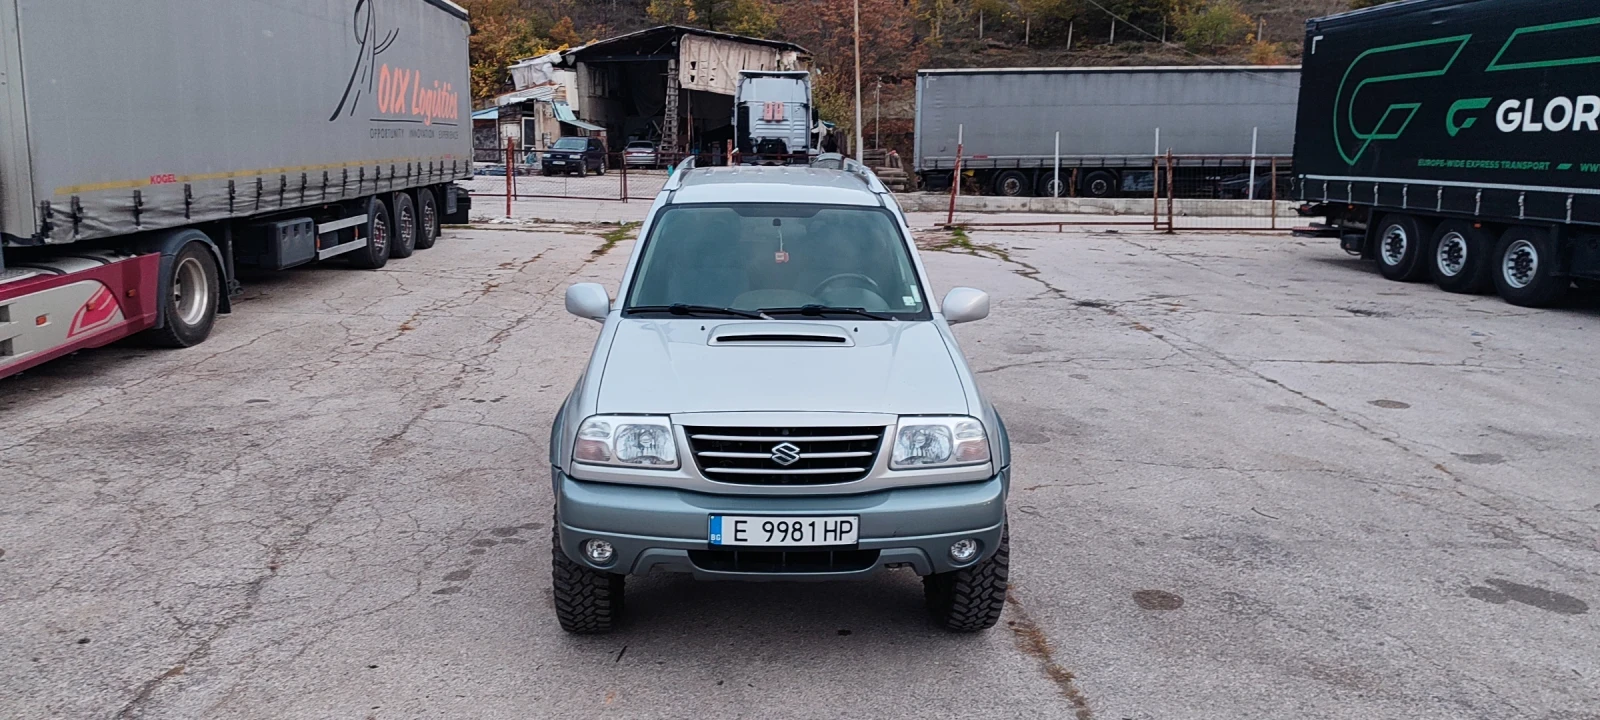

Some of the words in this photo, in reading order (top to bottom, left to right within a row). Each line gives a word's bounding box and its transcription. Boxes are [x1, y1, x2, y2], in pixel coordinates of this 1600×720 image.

[378, 63, 411, 115] OIX
[411, 69, 458, 127] Logistics
[1495, 95, 1600, 132] GLOR
[1417, 158, 1465, 168] EUROPE-WIDE
[1465, 160, 1500, 169] EXPRESS
[1500, 161, 1551, 171] TRANSPORT
[1579, 163, 1600, 173] WW
[710, 533, 721, 541] BG
[734, 520, 748, 542] E
